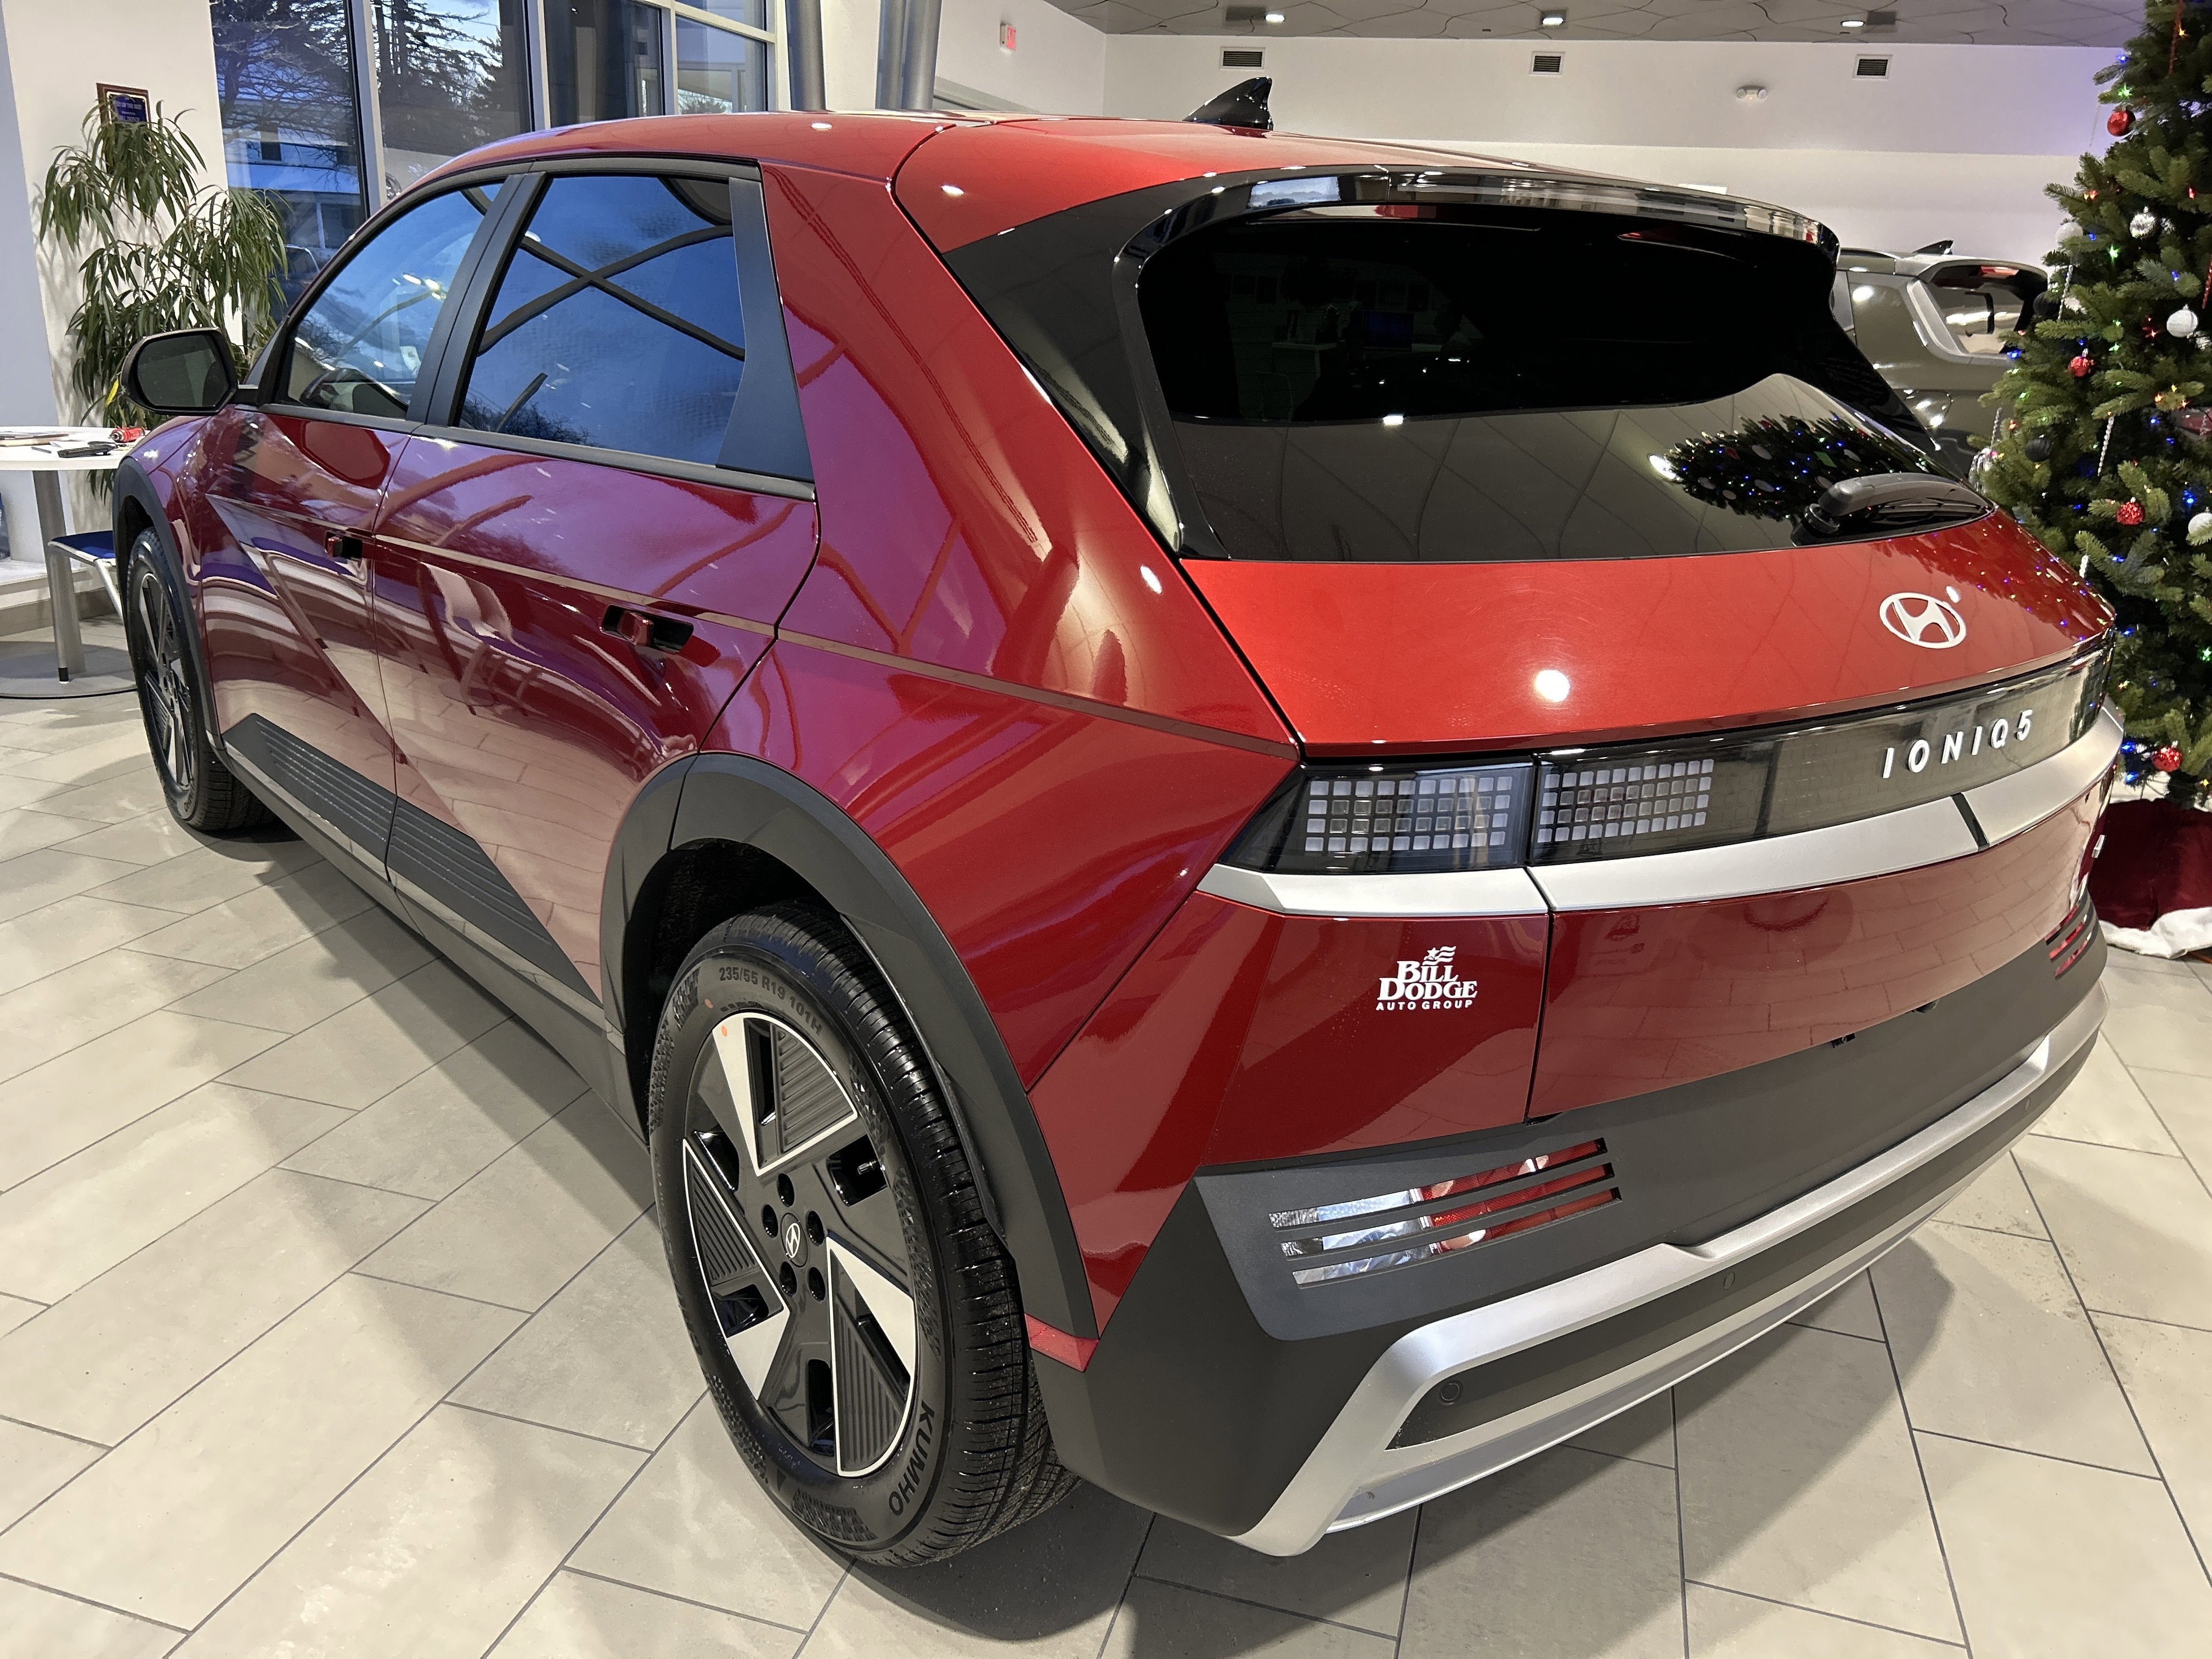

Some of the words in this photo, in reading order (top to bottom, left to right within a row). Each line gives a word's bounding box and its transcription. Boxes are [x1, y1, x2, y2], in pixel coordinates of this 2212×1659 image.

[1397, 961, 1459, 983] BILL
[1376, 978, 1478, 1001] DODGE
[719, 967, 758, 985] 235/55
[762, 975, 786, 1000] R19
[789, 996, 823, 1036] 101H
[1375, 1002, 1416, 1011] AUTO
[1421, 1000, 1472, 1009] GROUP
[889, 1400, 935, 1516] KUMHO
